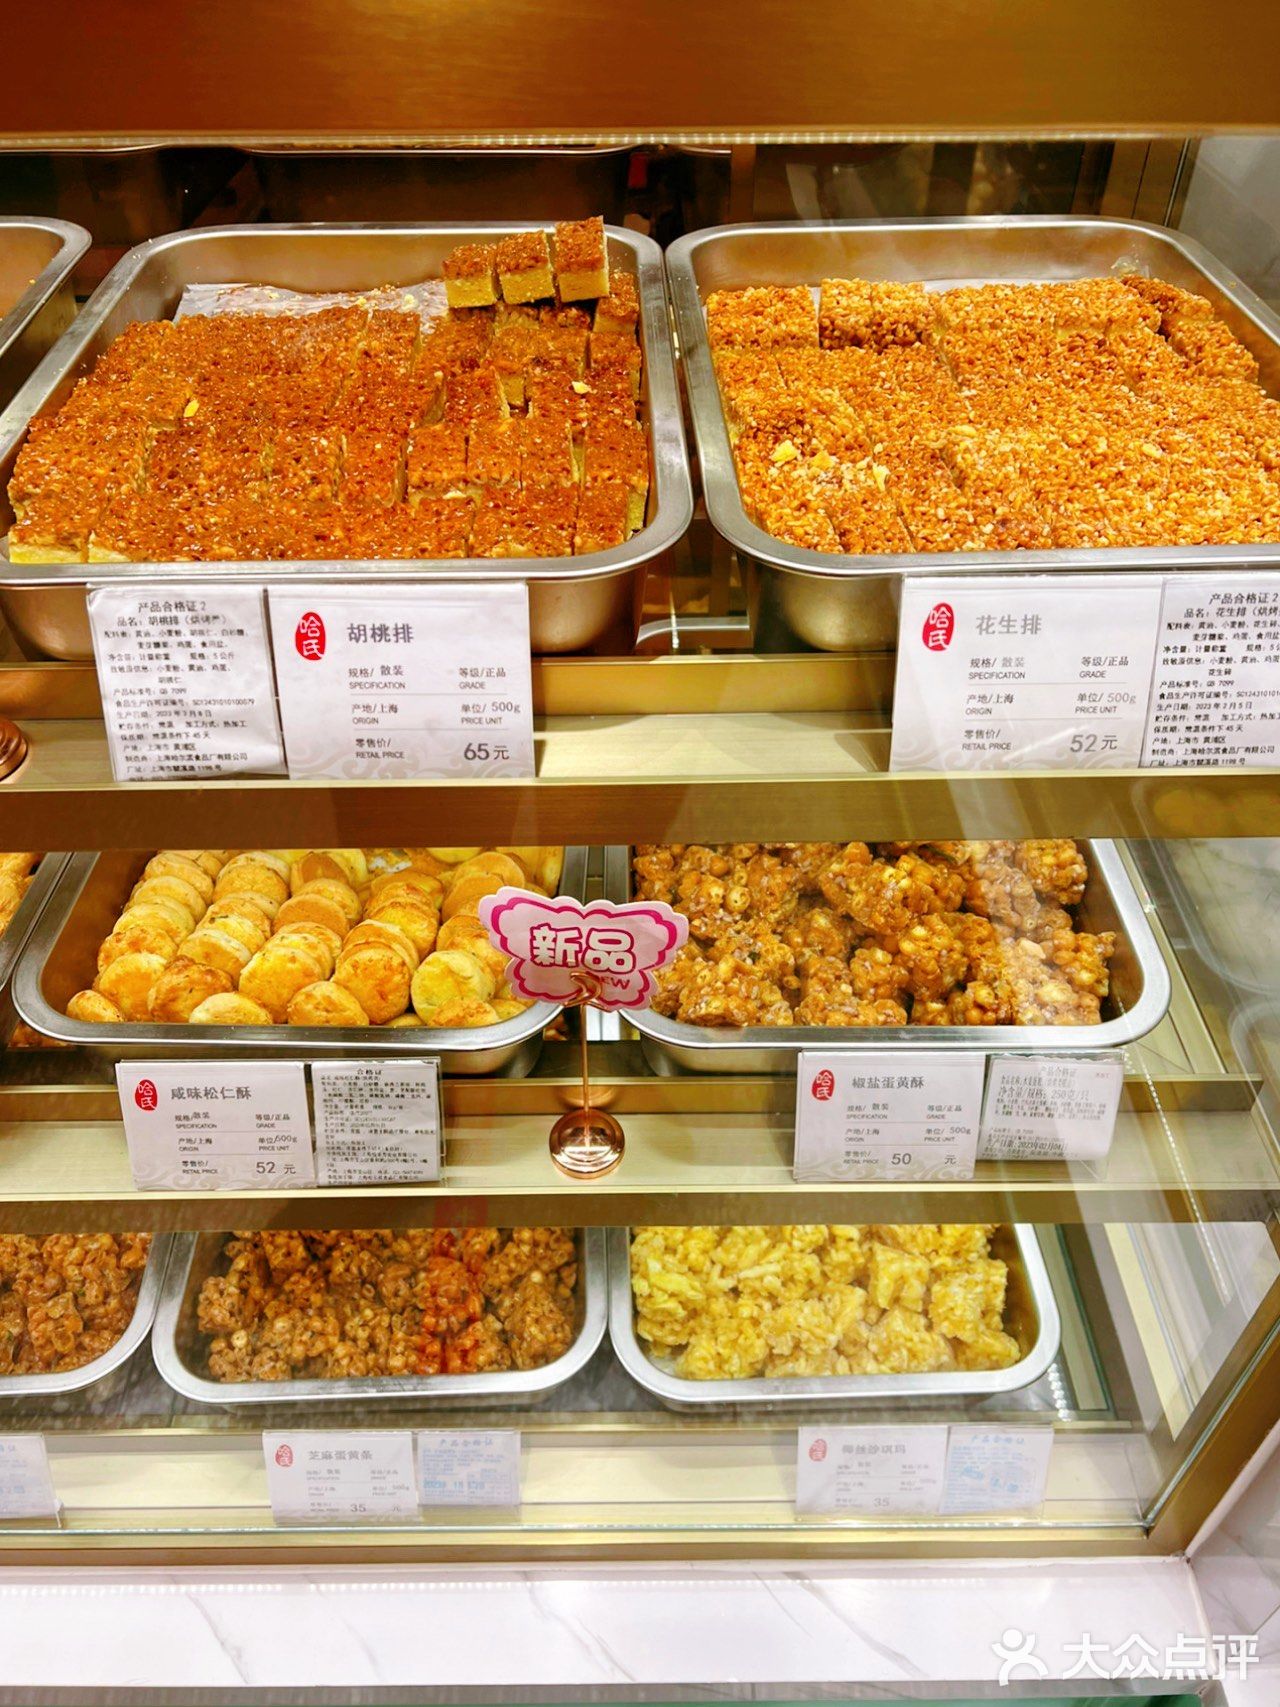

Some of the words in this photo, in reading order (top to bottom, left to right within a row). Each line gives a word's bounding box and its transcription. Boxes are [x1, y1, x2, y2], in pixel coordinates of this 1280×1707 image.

[928, 605, 951, 649] 哈氏
[976, 614, 1042, 636] 花生排
[299, 615, 325, 659] 哈氏
[348, 623, 414, 643] 胡桃排
[1080, 671, 1106, 679] GRADE
[349, 682, 405, 690] SPECIFICATION
[459, 682, 485, 690] GRADE
[966, 707, 992, 715] ORIGIN
[1075, 706, 1098, 714] PRICE
[353, 717, 379, 725] ORIGIN
[461, 717, 483, 725] PRICE
[485, 717, 502, 725] UNIT
[989, 742, 1011, 750] PRICE
[356, 751, 380, 759] RETAIL
[382, 751, 404, 759] PRICE
[530, 923, 636, 974] 新品
[816, 1072, 833, 1099] 哈氏
[852, 1077, 924, 1089] 椒盐蛋黄酥
[138, 1082, 156, 1109] 哈氏
[171, 1087, 251, 1099] 咸味松仁酥
[891, 1153, 911, 1165] 50
[350, 1504, 366, 1512] 35
